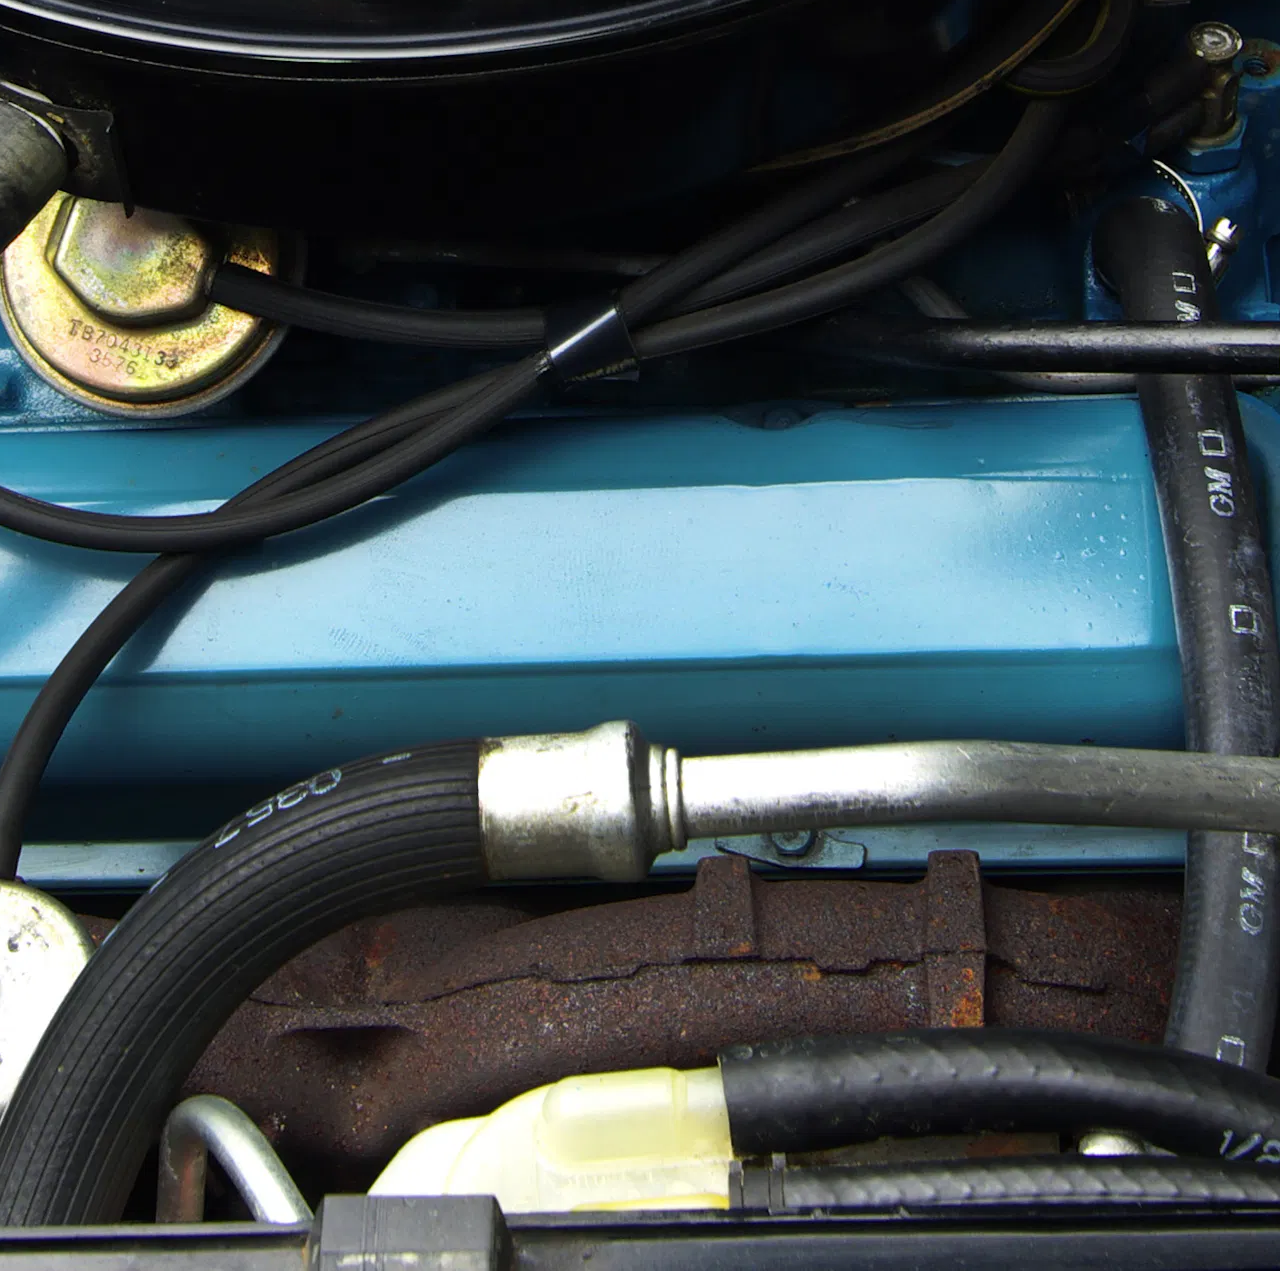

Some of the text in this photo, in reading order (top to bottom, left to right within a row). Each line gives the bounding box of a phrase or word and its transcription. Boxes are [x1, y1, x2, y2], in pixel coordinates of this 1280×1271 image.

[1174, 299, 1200, 322] M
[1205, 466, 1236, 518] GM
[1239, 865, 1266, 936] GM
